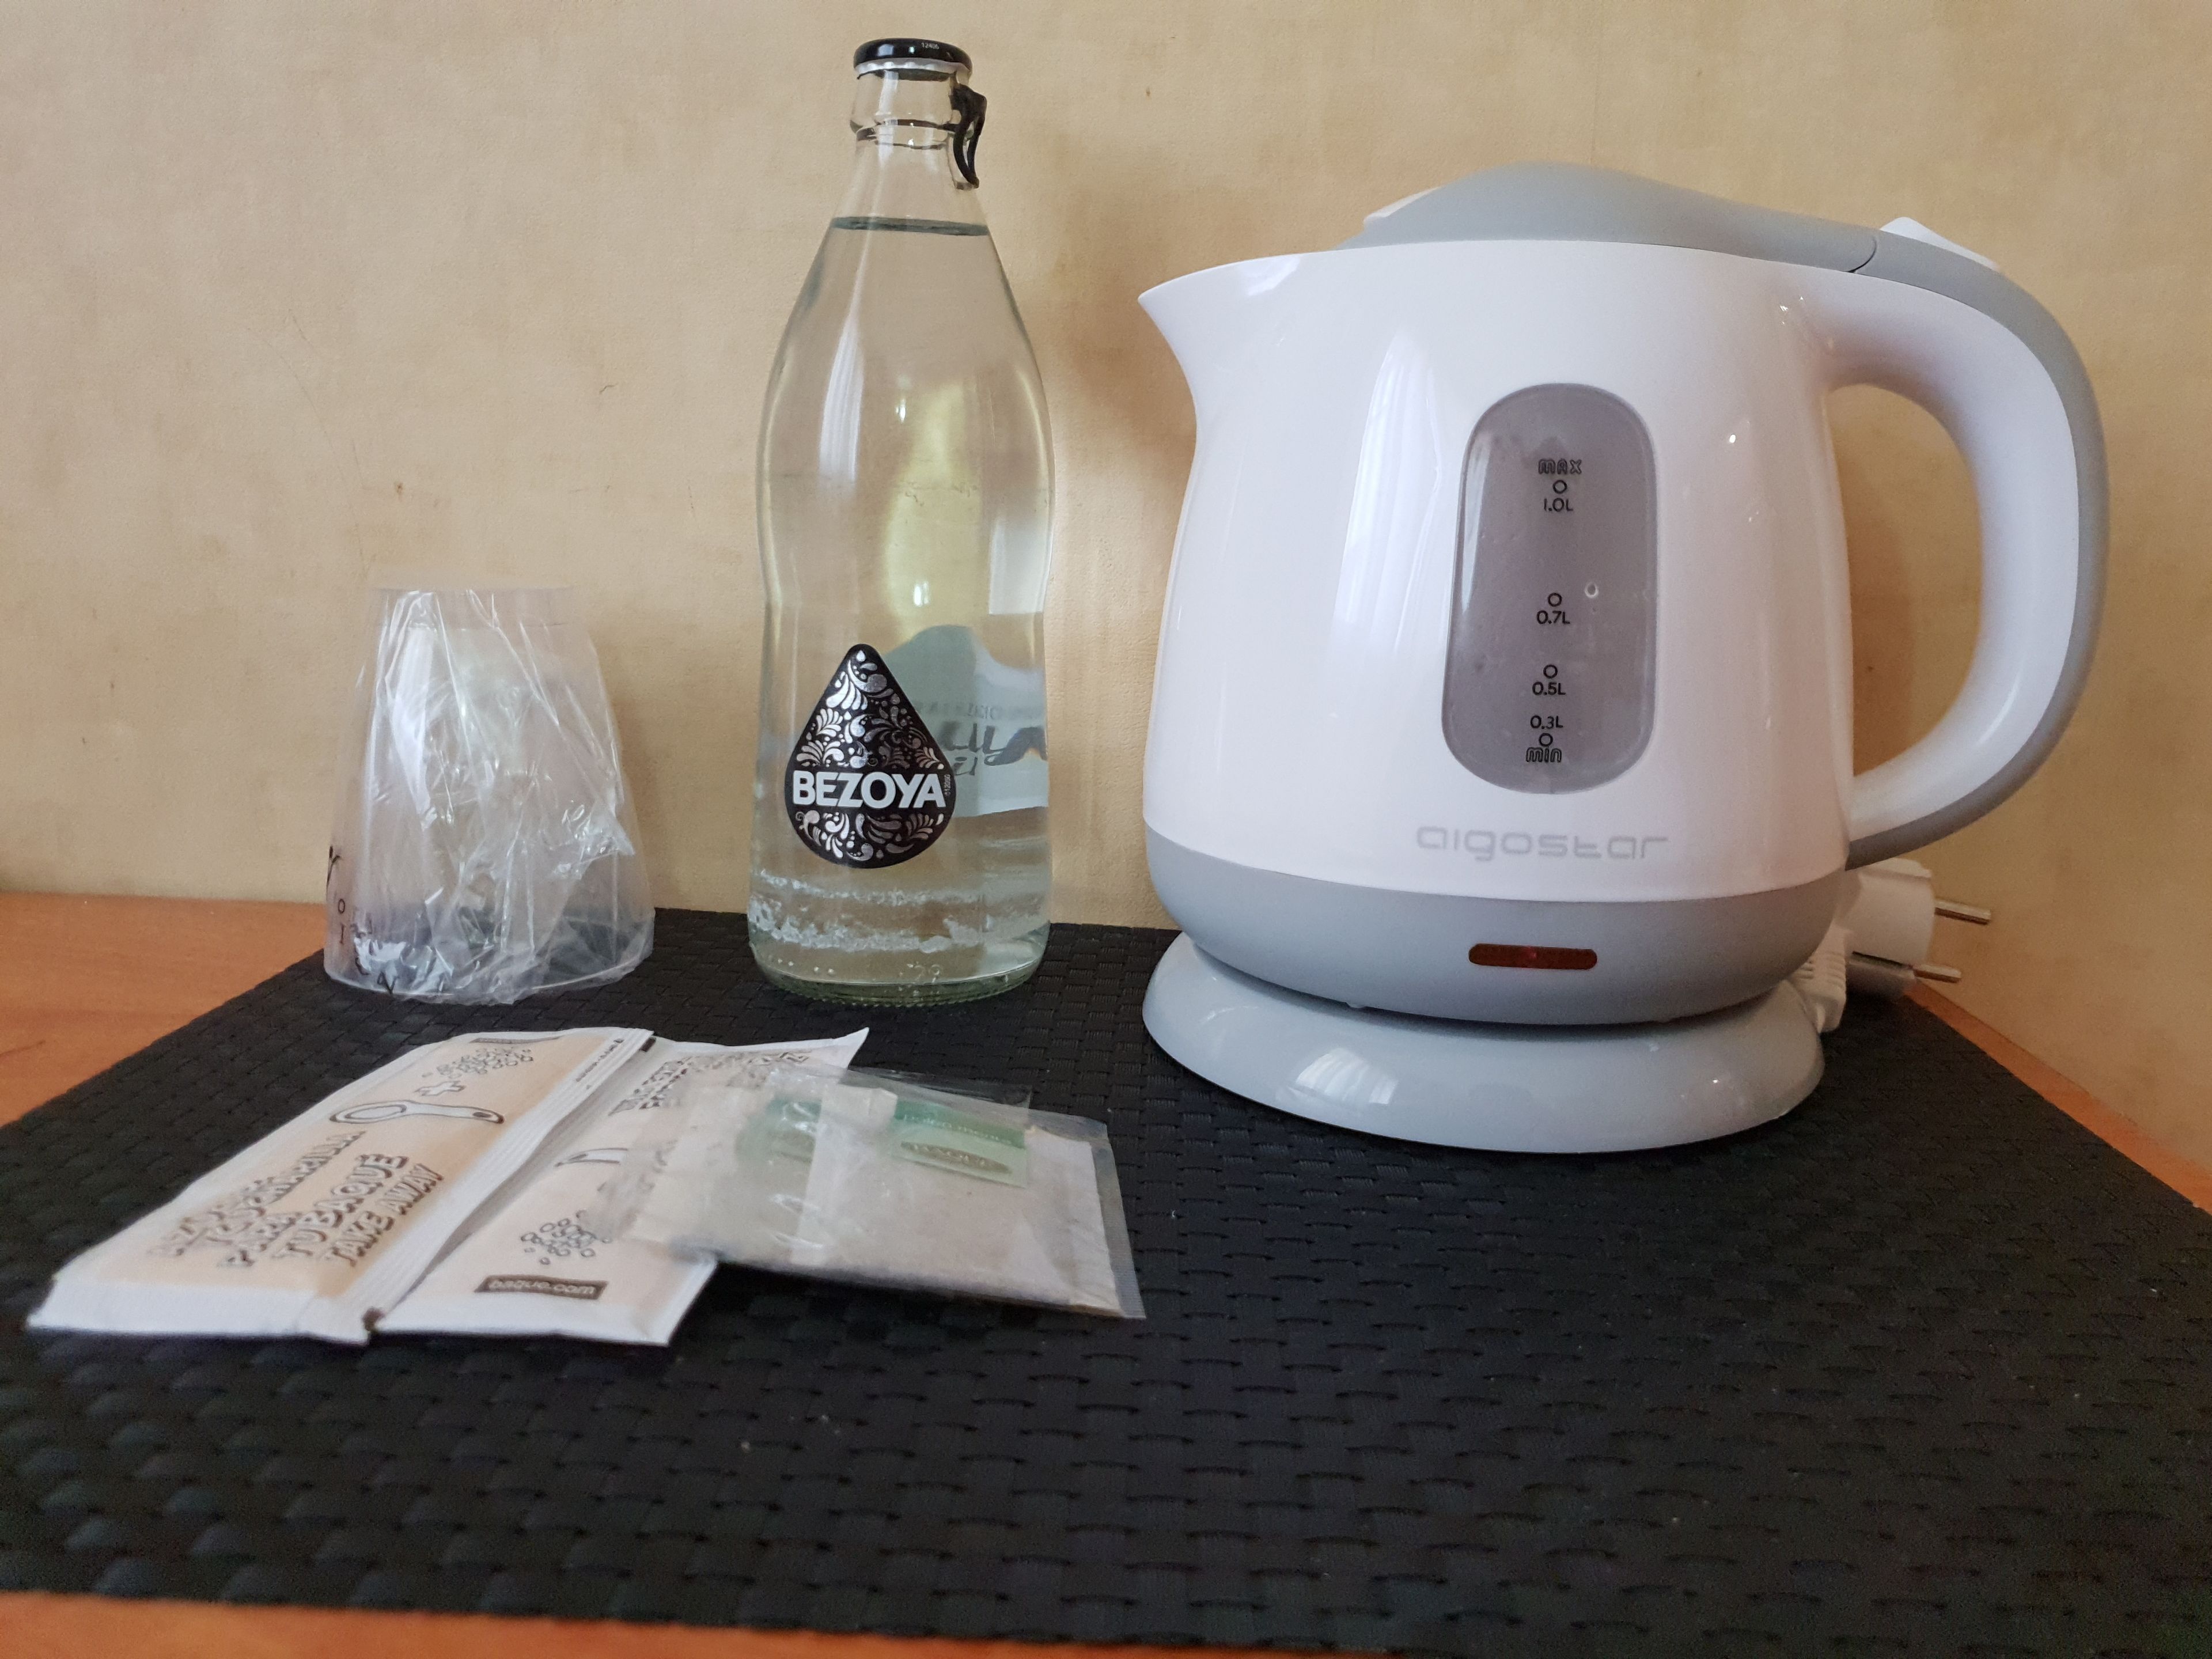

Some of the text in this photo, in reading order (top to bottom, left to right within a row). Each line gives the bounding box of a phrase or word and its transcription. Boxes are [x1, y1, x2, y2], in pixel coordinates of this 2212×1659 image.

[1544, 498, 1573, 512] 1.0L
[1536, 610, 1570, 625] 0.7L
[1532, 681, 1566, 696] 0.5L
[1530, 715, 1563, 729] 0.3L
[793, 770, 946, 808] BEZOYA
[1416, 826, 1669, 861] aigostar
[272, 1153, 410, 1260] TU BAQUÉ
[320, 1162, 444, 1267] TAKE AWAY
[217, 1212, 302, 1267] PARA
